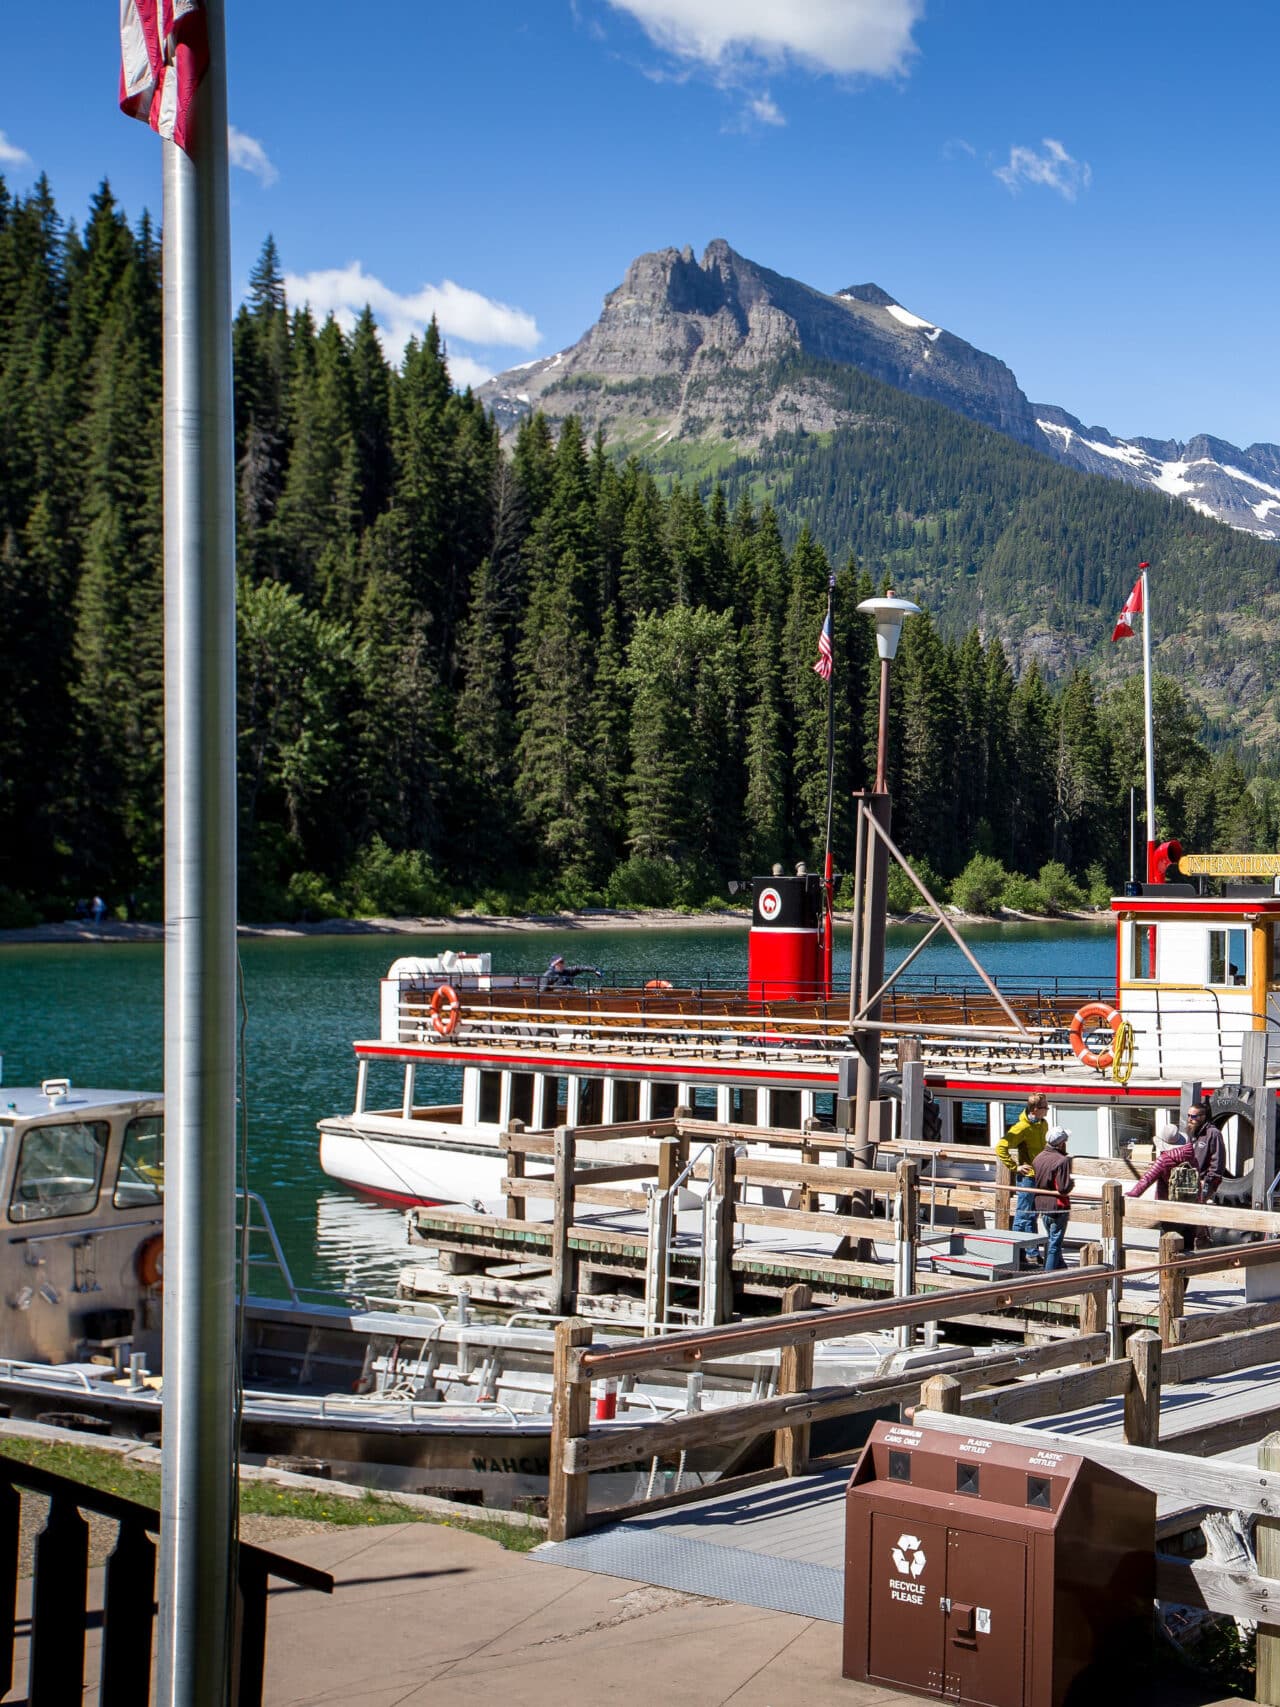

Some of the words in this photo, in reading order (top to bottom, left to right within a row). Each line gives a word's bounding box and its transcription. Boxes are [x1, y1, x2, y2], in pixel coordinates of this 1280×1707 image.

[885, 1435, 902, 1443] CANS
[903, 1438, 920, 1446] ONLY
[968, 1439, 992, 1448] PLASTIC
[959, 1444, 986, 1453] BOTTLES
[1038, 1451, 1063, 1461] PLASTIC
[1029, 1457, 1056, 1467] BOTTLES
[889, 1579, 926, 1594] RECYCLE
[891, 1590, 924, 1605] PLEASE
